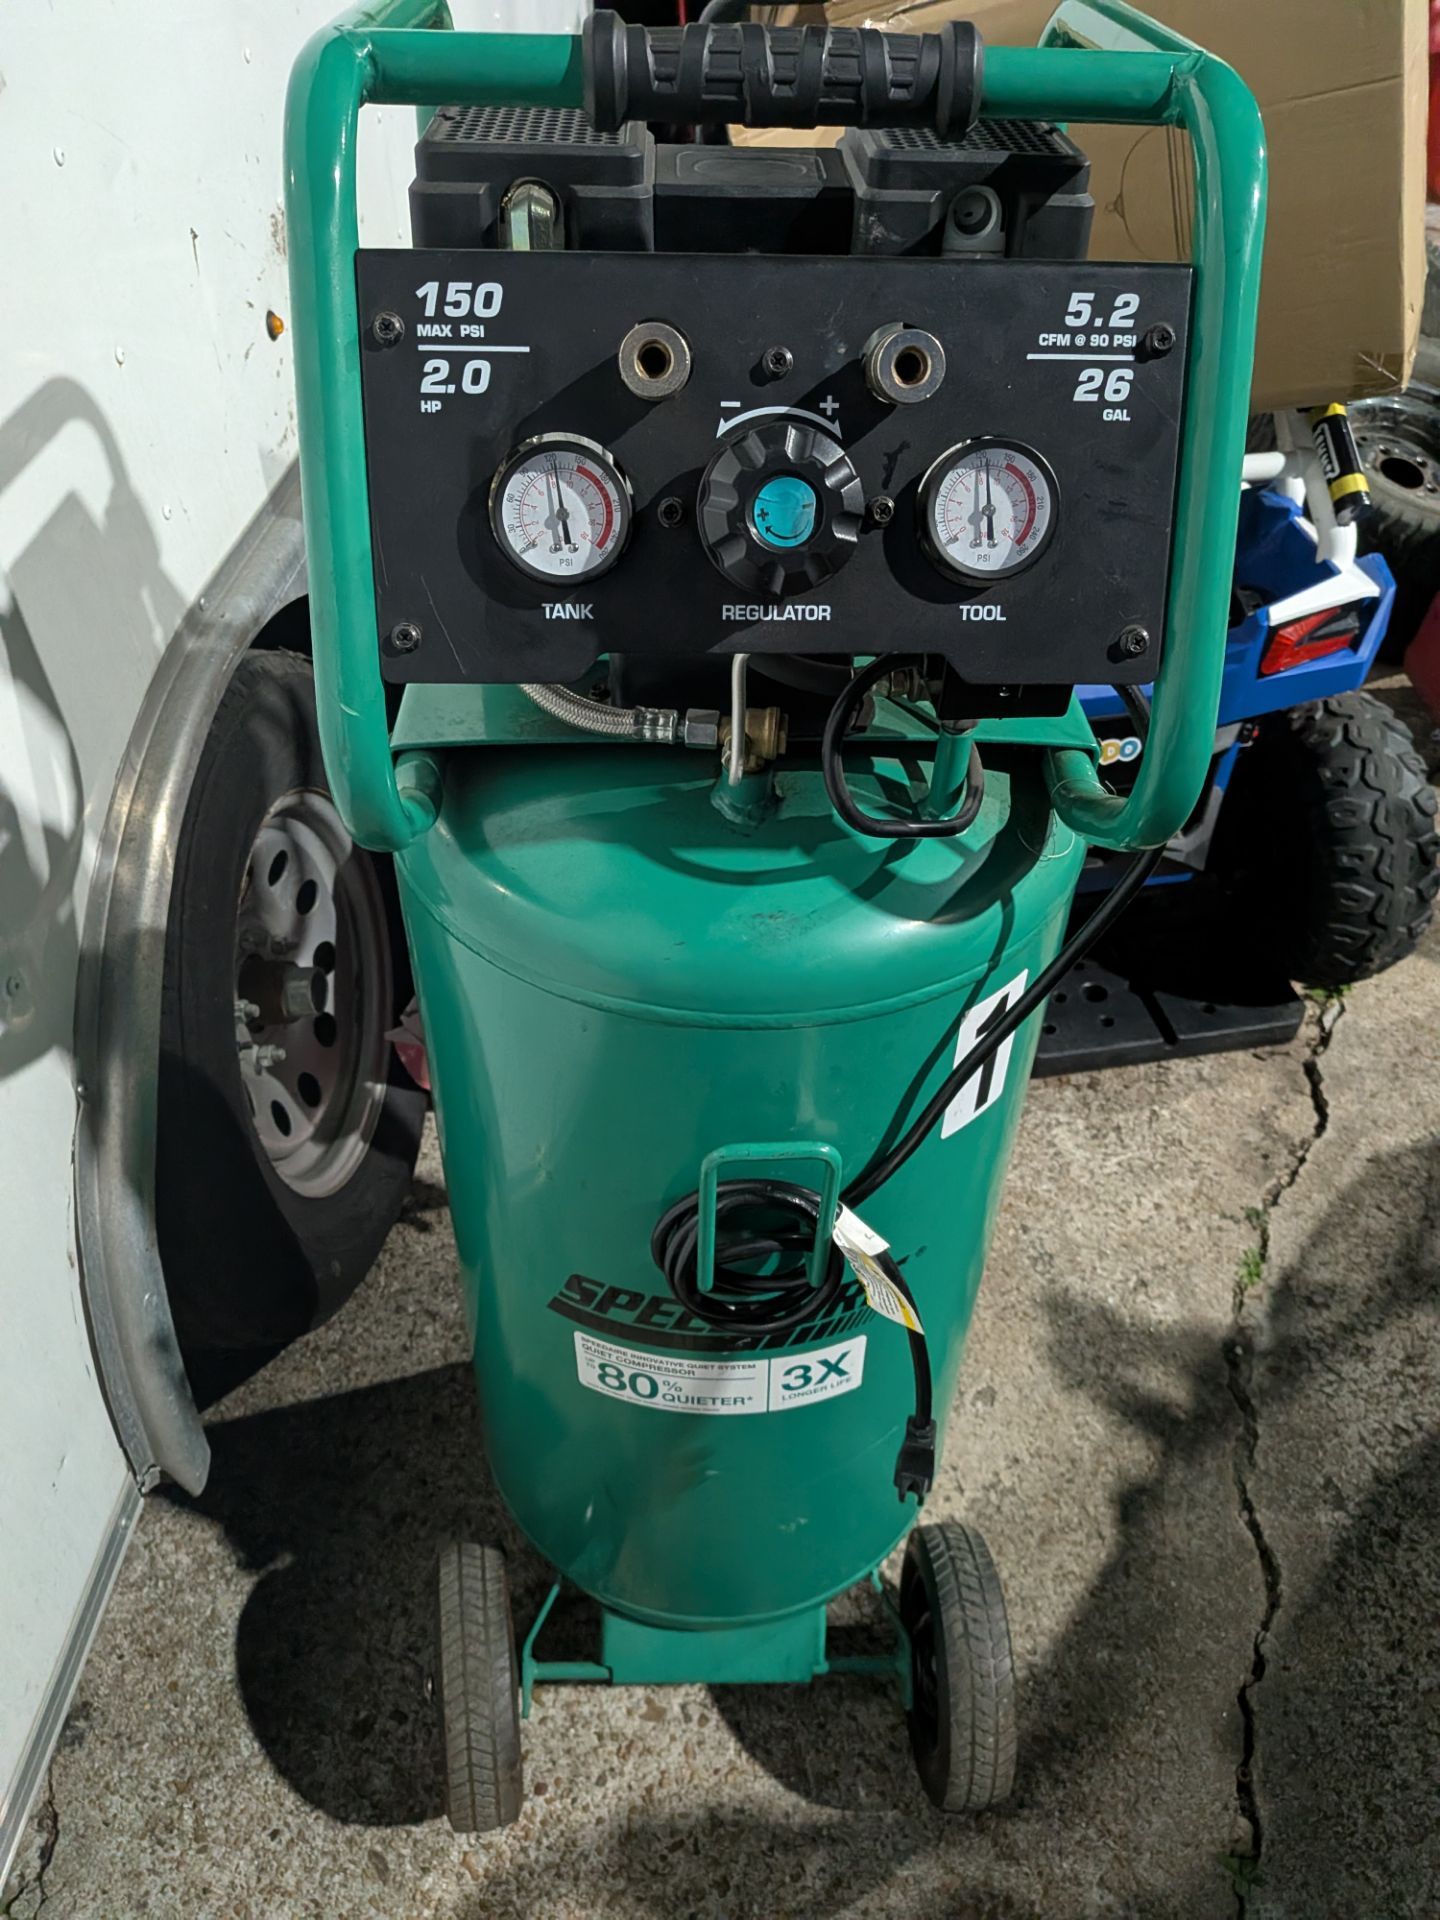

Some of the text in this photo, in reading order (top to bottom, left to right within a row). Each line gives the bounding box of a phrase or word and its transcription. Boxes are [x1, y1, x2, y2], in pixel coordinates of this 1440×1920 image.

[416, 282, 503, 318] 150
[1064, 292, 1140, 328] 5.2
[417, 324, 485, 338] MAX PSI
[1038, 334, 1071, 347] CFM
[1090, 334, 1110, 347] 90
[1113, 335, 1137, 347] PSI
[420, 359, 492, 395] 2.0
[1073, 368, 1134, 402] 26
[421, 400, 442, 413] HP
[1102, 409, 1131, 422] GAL
[559, 559, 573, 567] PSI
[976, 554, 991, 563] PSI
[542, 604, 594, 620] TANK
[722, 604, 831, 621] REGULATOR
[960, 606, 1006, 621] TOOL
[582, 1343, 695, 1377] QUIET COMPRESSOR
[630, 1353, 685, 1368] INNOVATIVE
[781, 1350, 852, 1391] 3X
[597, 1362, 659, 1399] 80
[782, 1376, 853, 1402] LONGER LIFE
